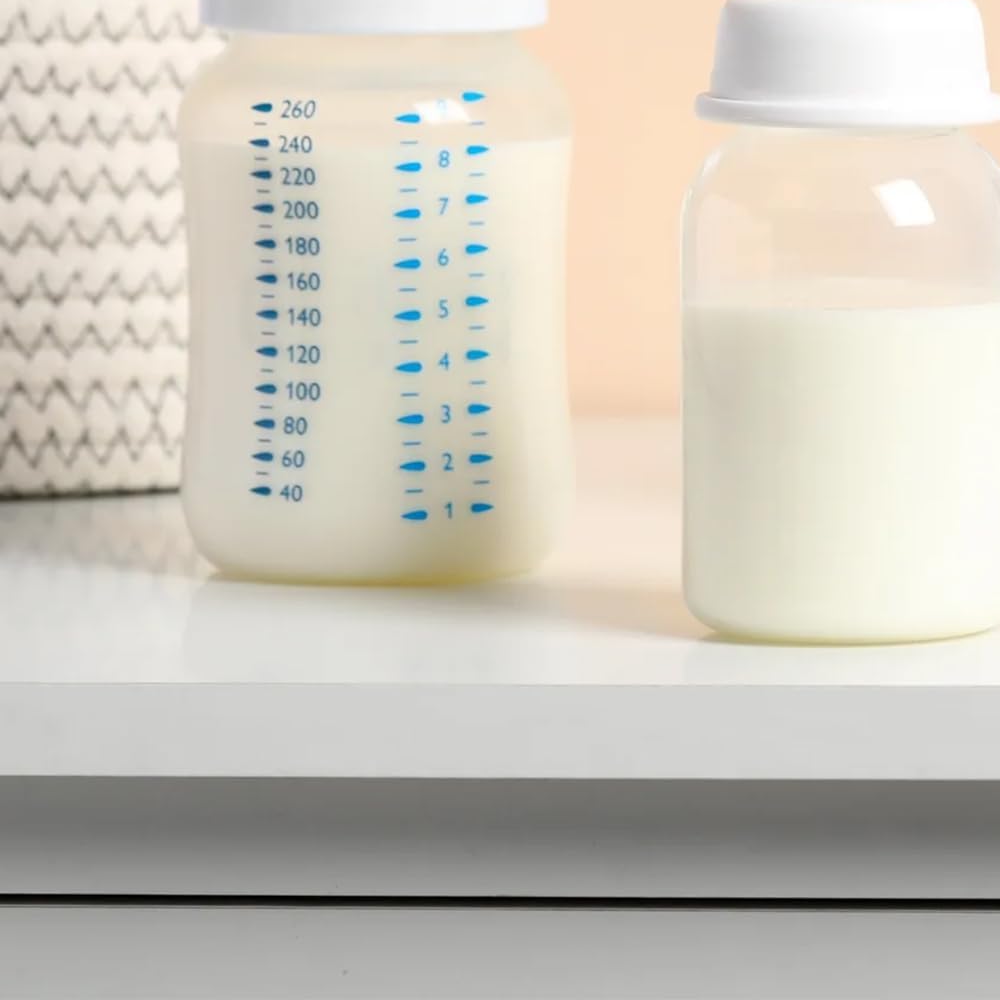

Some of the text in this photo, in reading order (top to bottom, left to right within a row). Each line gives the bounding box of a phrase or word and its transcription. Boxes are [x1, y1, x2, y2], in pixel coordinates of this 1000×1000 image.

[281, 100, 317, 119] 260
[278, 135, 313, 154] 240
[438, 150, 450, 168] 8
[281, 167, 316, 186] 220
[283, 201, 319, 220] 200
[438, 197, 450, 215] 7
[285, 237, 320, 256] 180
[437, 248, 450, 267] 6
[287, 272, 321, 291] 160
[287, 308, 321, 327] 140
[438, 299, 450, 318] 5
[287, 345, 321, 364] 120
[438, 352, 450, 370] 4
[286, 382, 321, 401] 100
[441, 404, 451, 424] 3
[283, 416, 308, 435] 80
[281, 450, 305, 468] 60
[442, 452, 454, 471] 2
[279, 484, 304, 502] 40
[444, 501, 453, 519] 1
